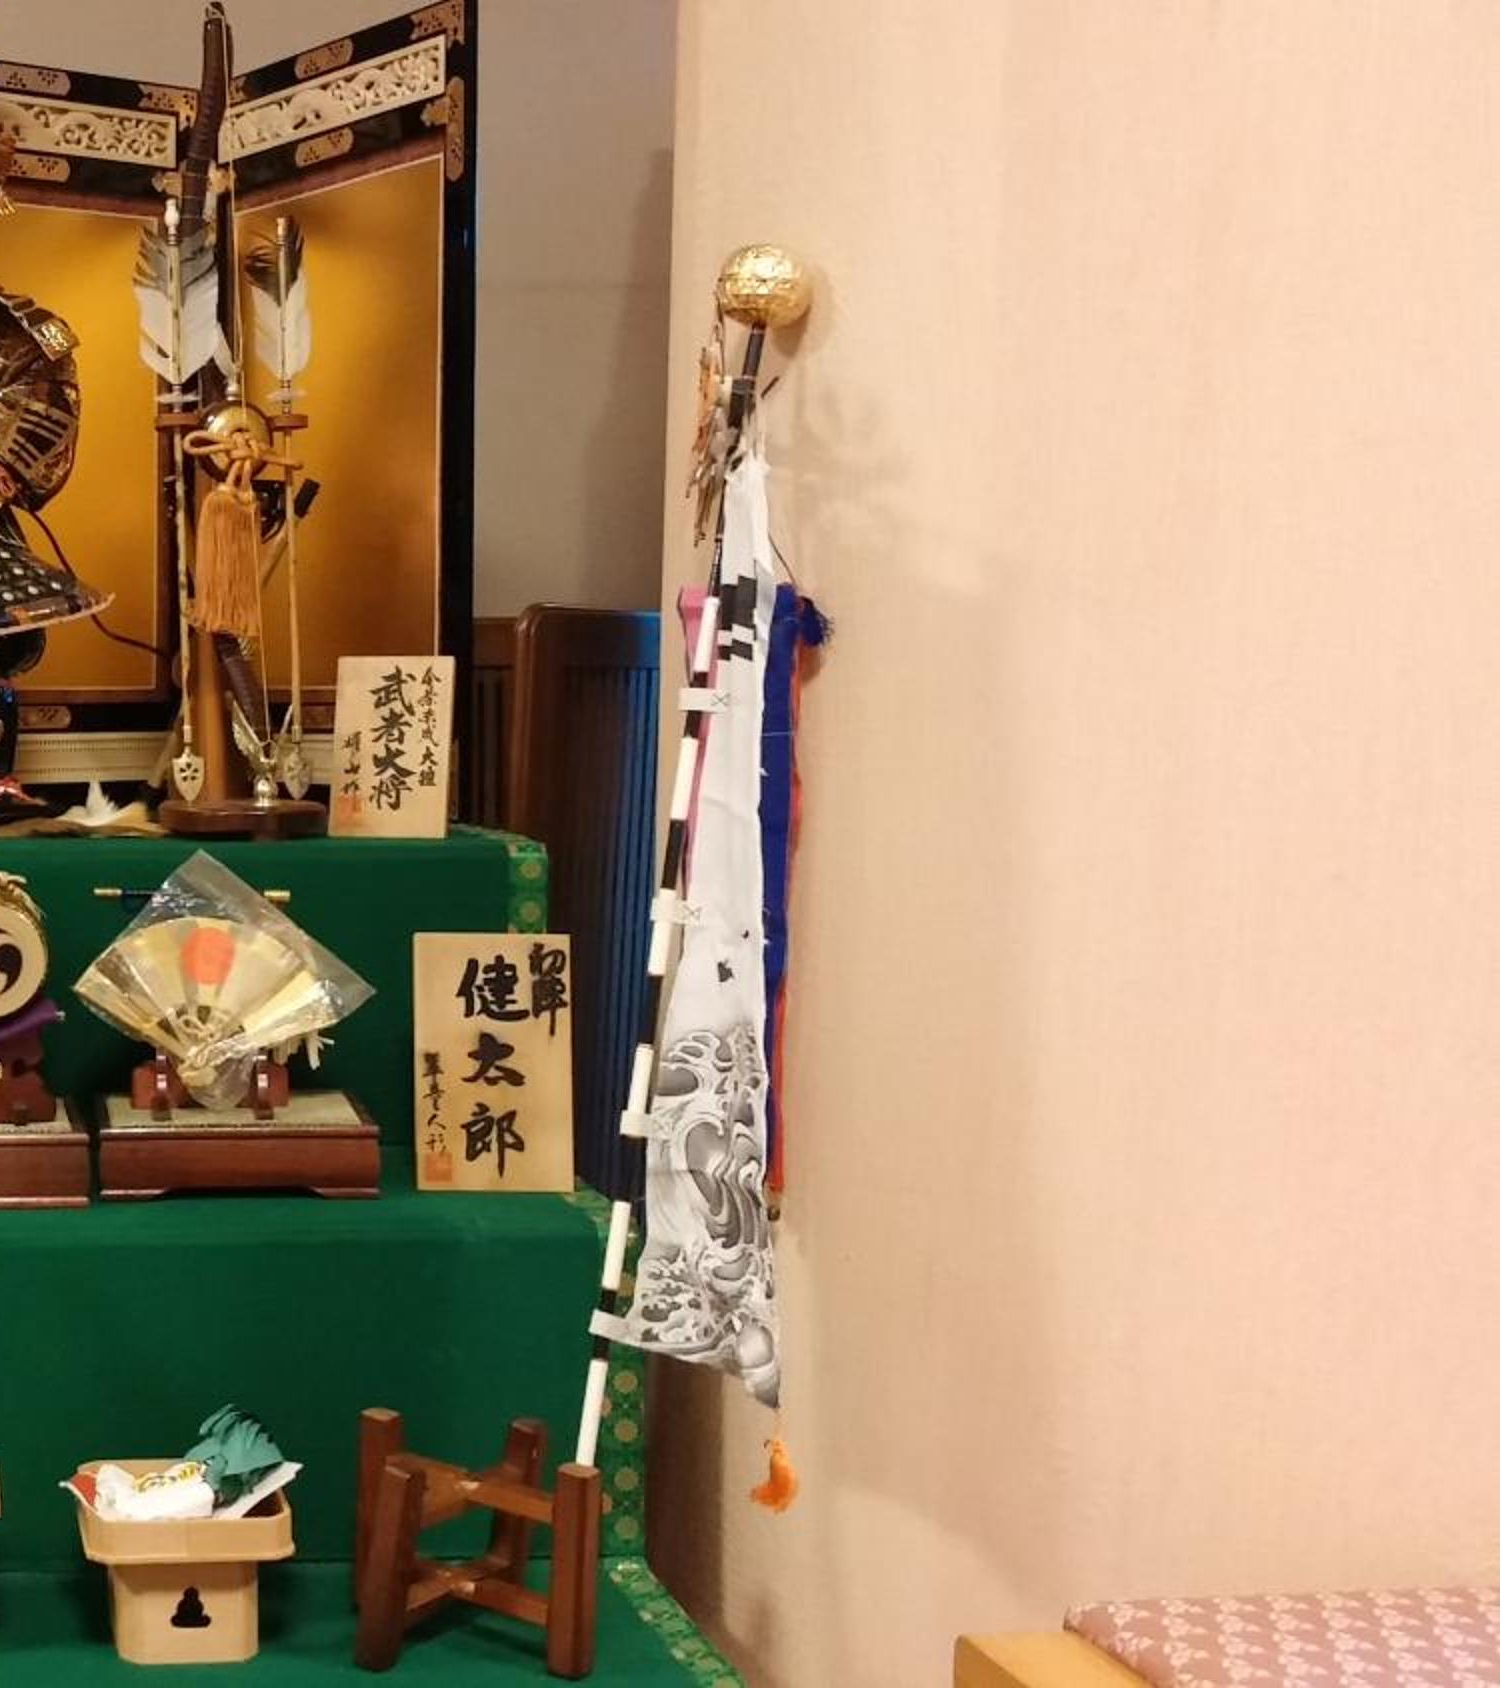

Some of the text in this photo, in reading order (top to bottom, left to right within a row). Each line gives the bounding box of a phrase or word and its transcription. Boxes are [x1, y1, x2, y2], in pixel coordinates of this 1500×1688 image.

[369, 665, 418, 811] 武者大将
[456, 954, 530, 1178] 健太郎
